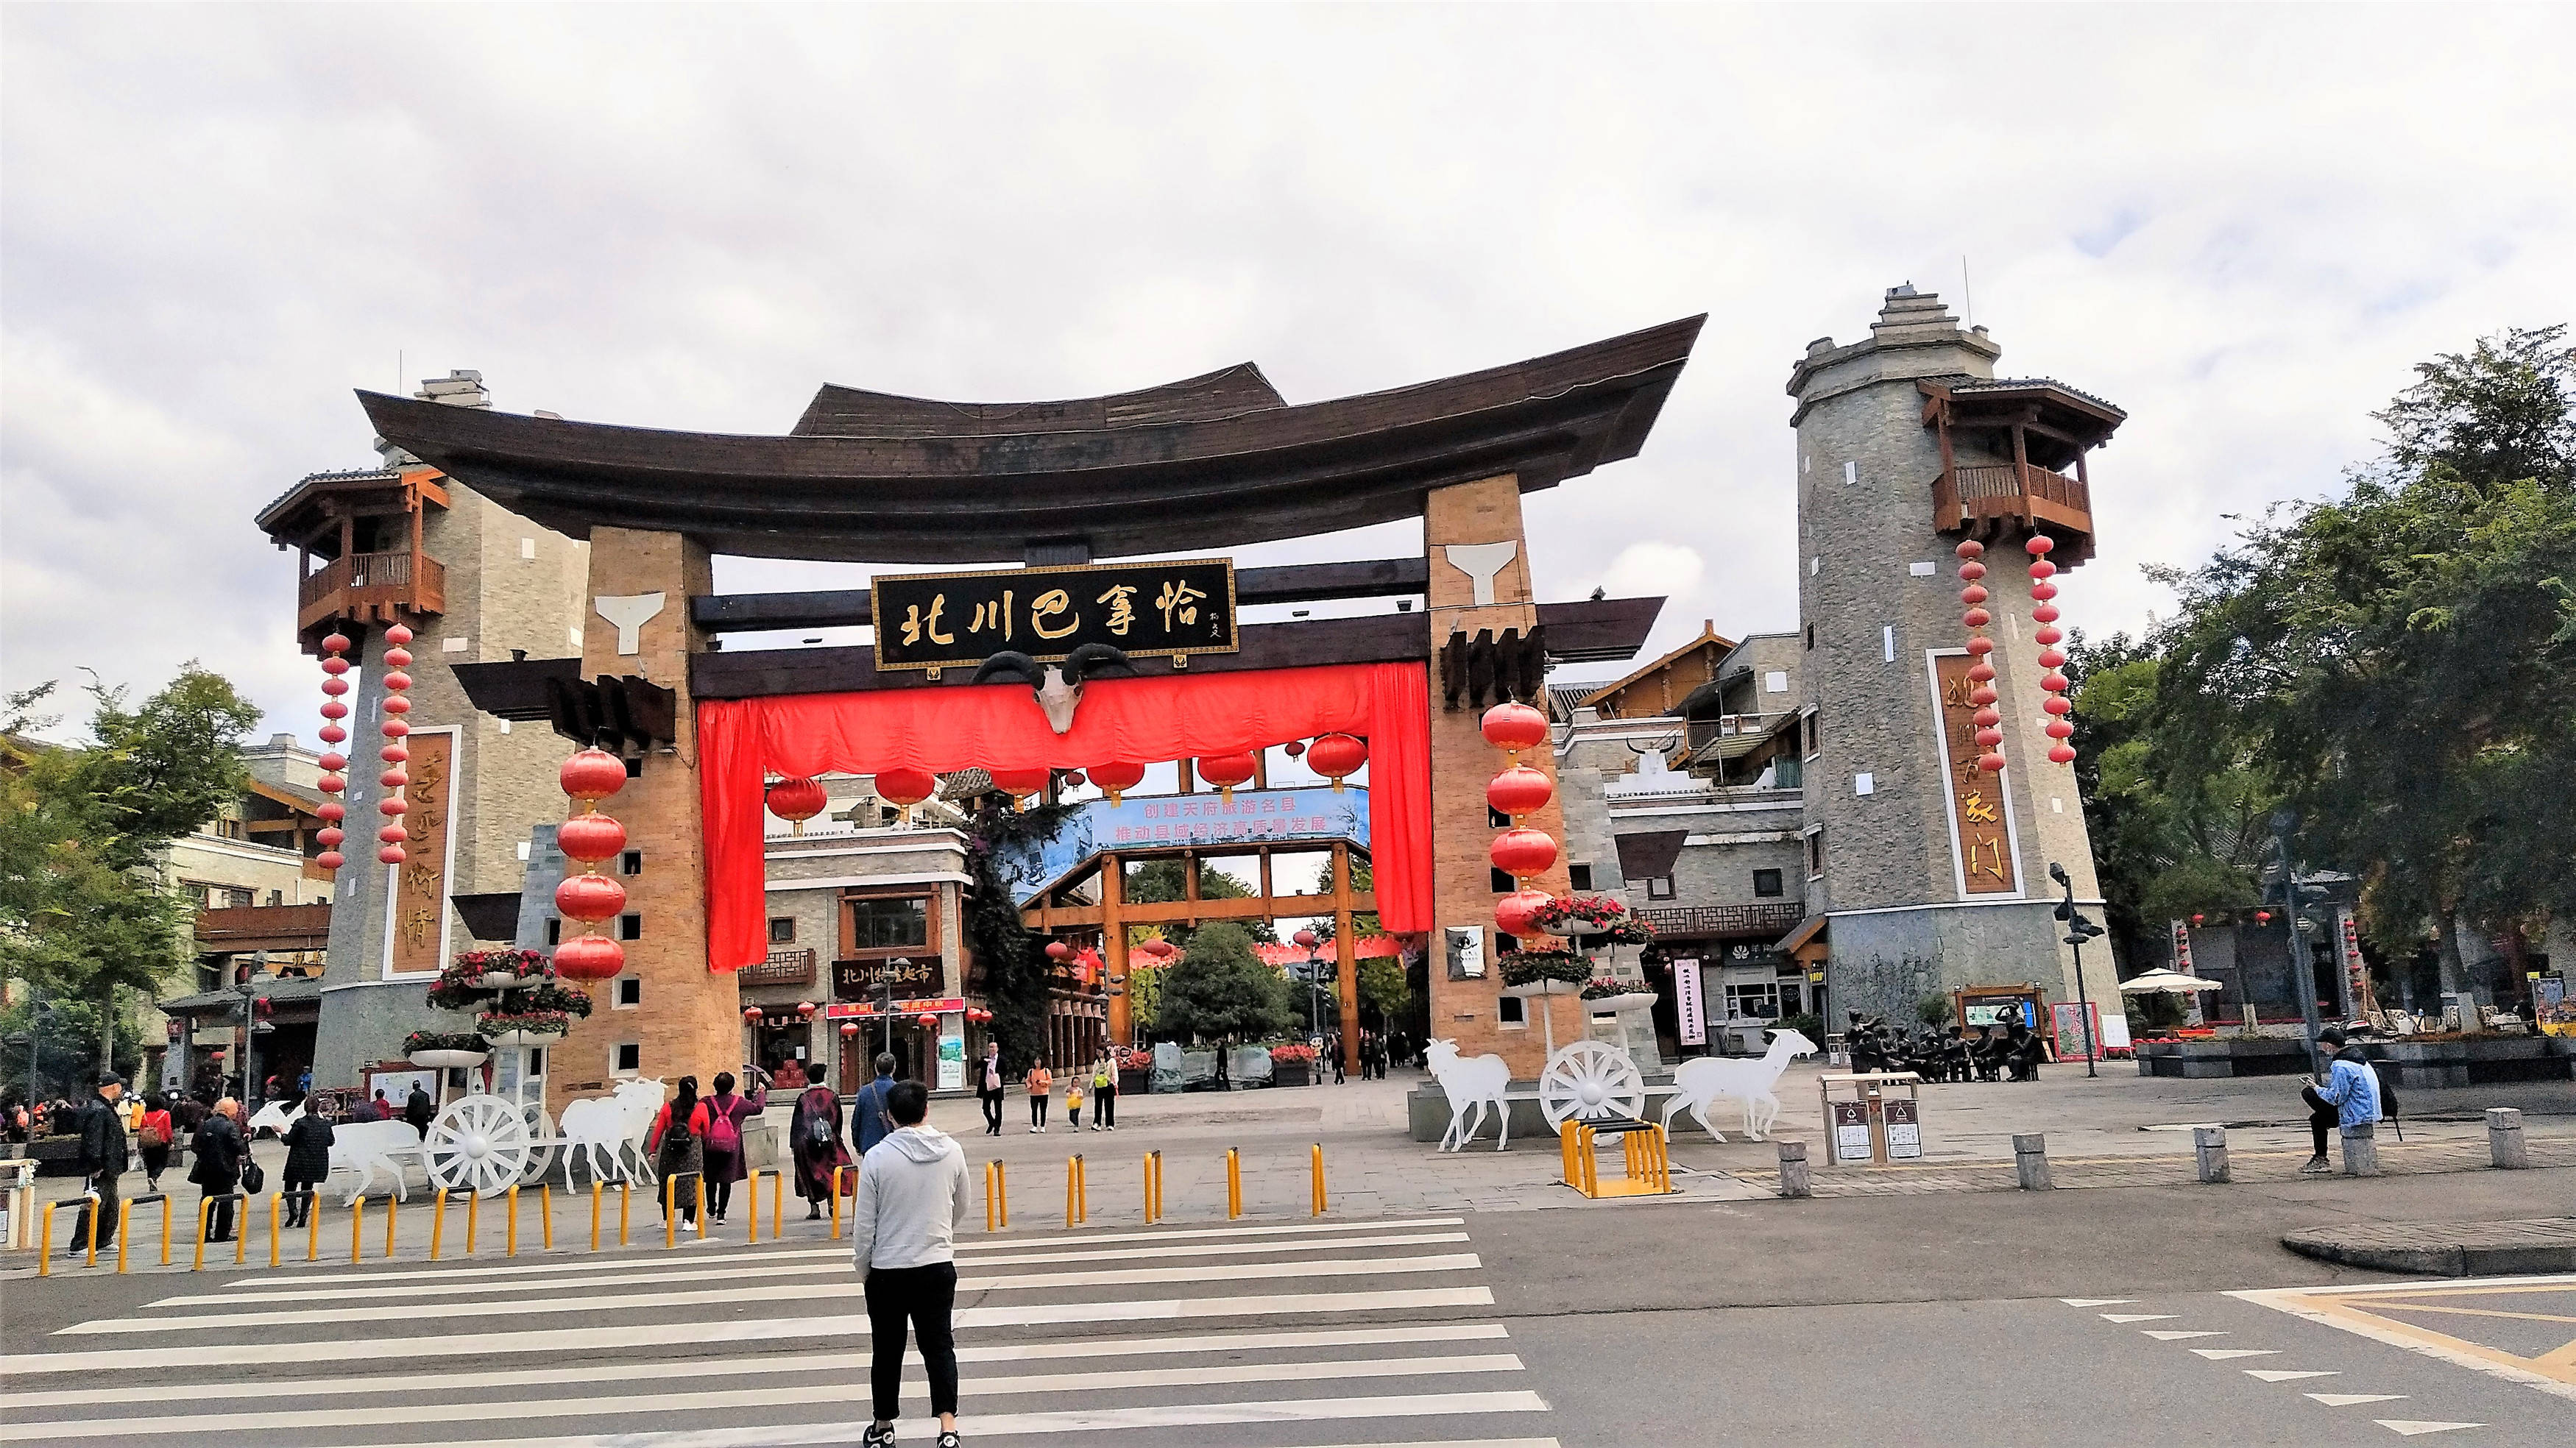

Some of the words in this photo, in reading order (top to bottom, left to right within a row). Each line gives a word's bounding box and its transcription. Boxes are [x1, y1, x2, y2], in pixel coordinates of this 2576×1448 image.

[900, 580, 1206, 646] 北川巴拿恰
[1144, 798, 1295, 818] 创建天府旅游名县
[1116, 817, 1326, 841] 推动县域经济高质量发展
